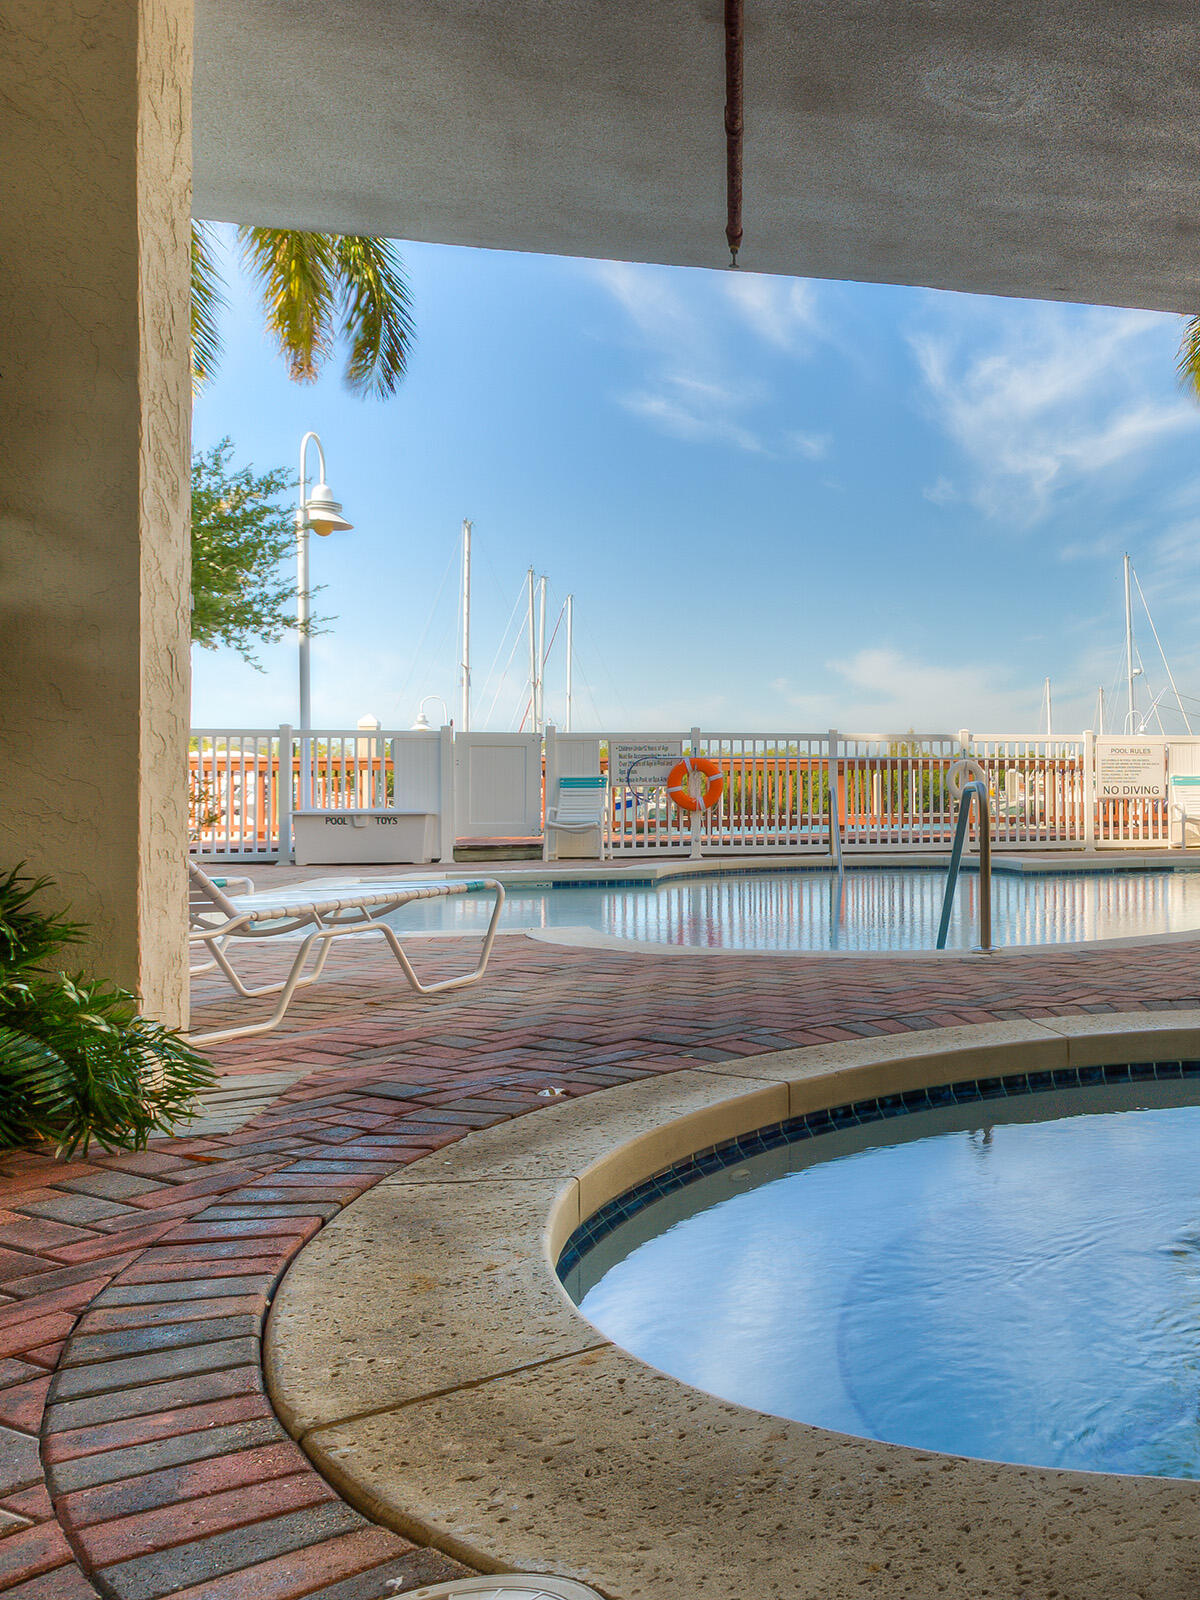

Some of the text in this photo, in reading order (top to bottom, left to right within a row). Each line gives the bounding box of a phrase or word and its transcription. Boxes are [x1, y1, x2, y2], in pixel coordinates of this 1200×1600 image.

[1103, 785, 1160, 795] NO DIVING
[325, 816, 398, 825] POOL TOYS
